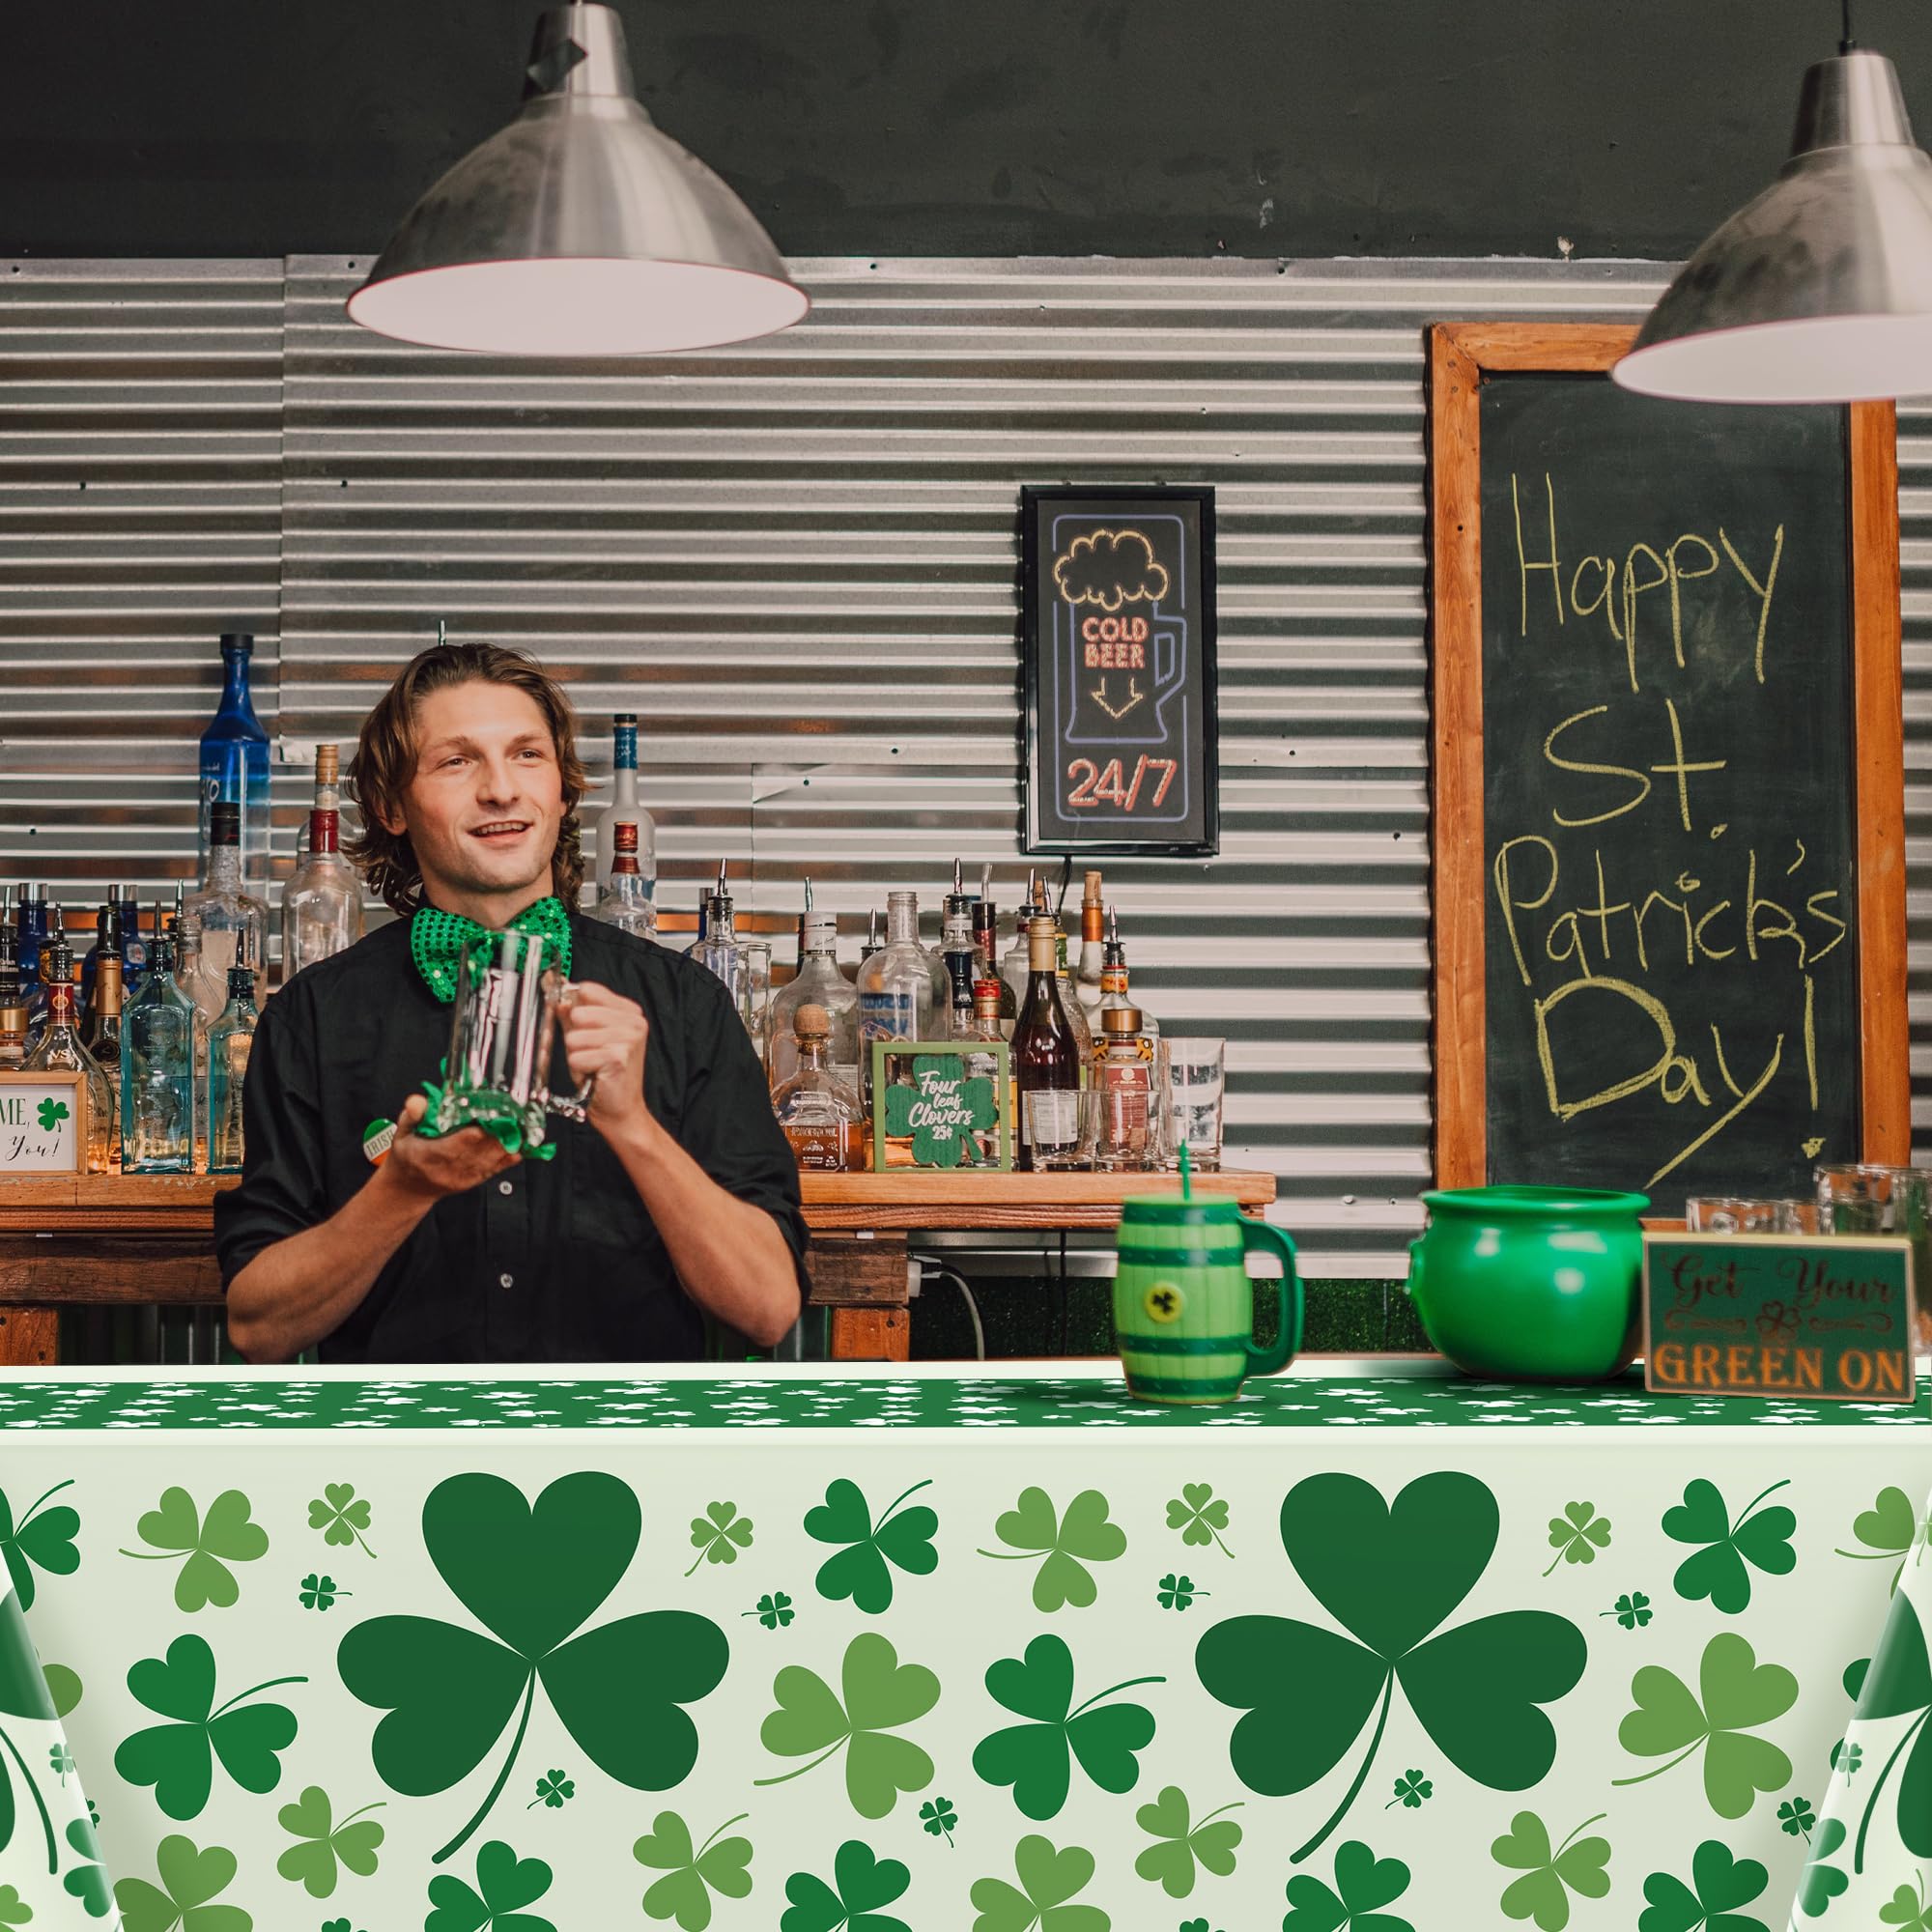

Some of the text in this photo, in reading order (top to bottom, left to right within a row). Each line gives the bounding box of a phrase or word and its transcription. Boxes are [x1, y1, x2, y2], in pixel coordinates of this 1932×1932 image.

[1512, 472, 1783, 694] Happy
[1081, 615, 1149, 642] COLD
[1083, 642, 1146, 668] BEER
[1066, 753, 1178, 812] 24/7
[1544, 697, 1727, 839] St.
[1494, 835, 1846, 985] Patrick's
[919, 1070, 962, 1097] Four
[933, 1093, 964, 1111] leaf
[1534, 974, 1826, 1189] Day!
[908, 1102, 976, 1127] Clovers
[6, 1135, 60, 1162] You!
[1661, 1252, 1897, 1310] Get Your
[1653, 1343, 1906, 1392] GREEN ON
